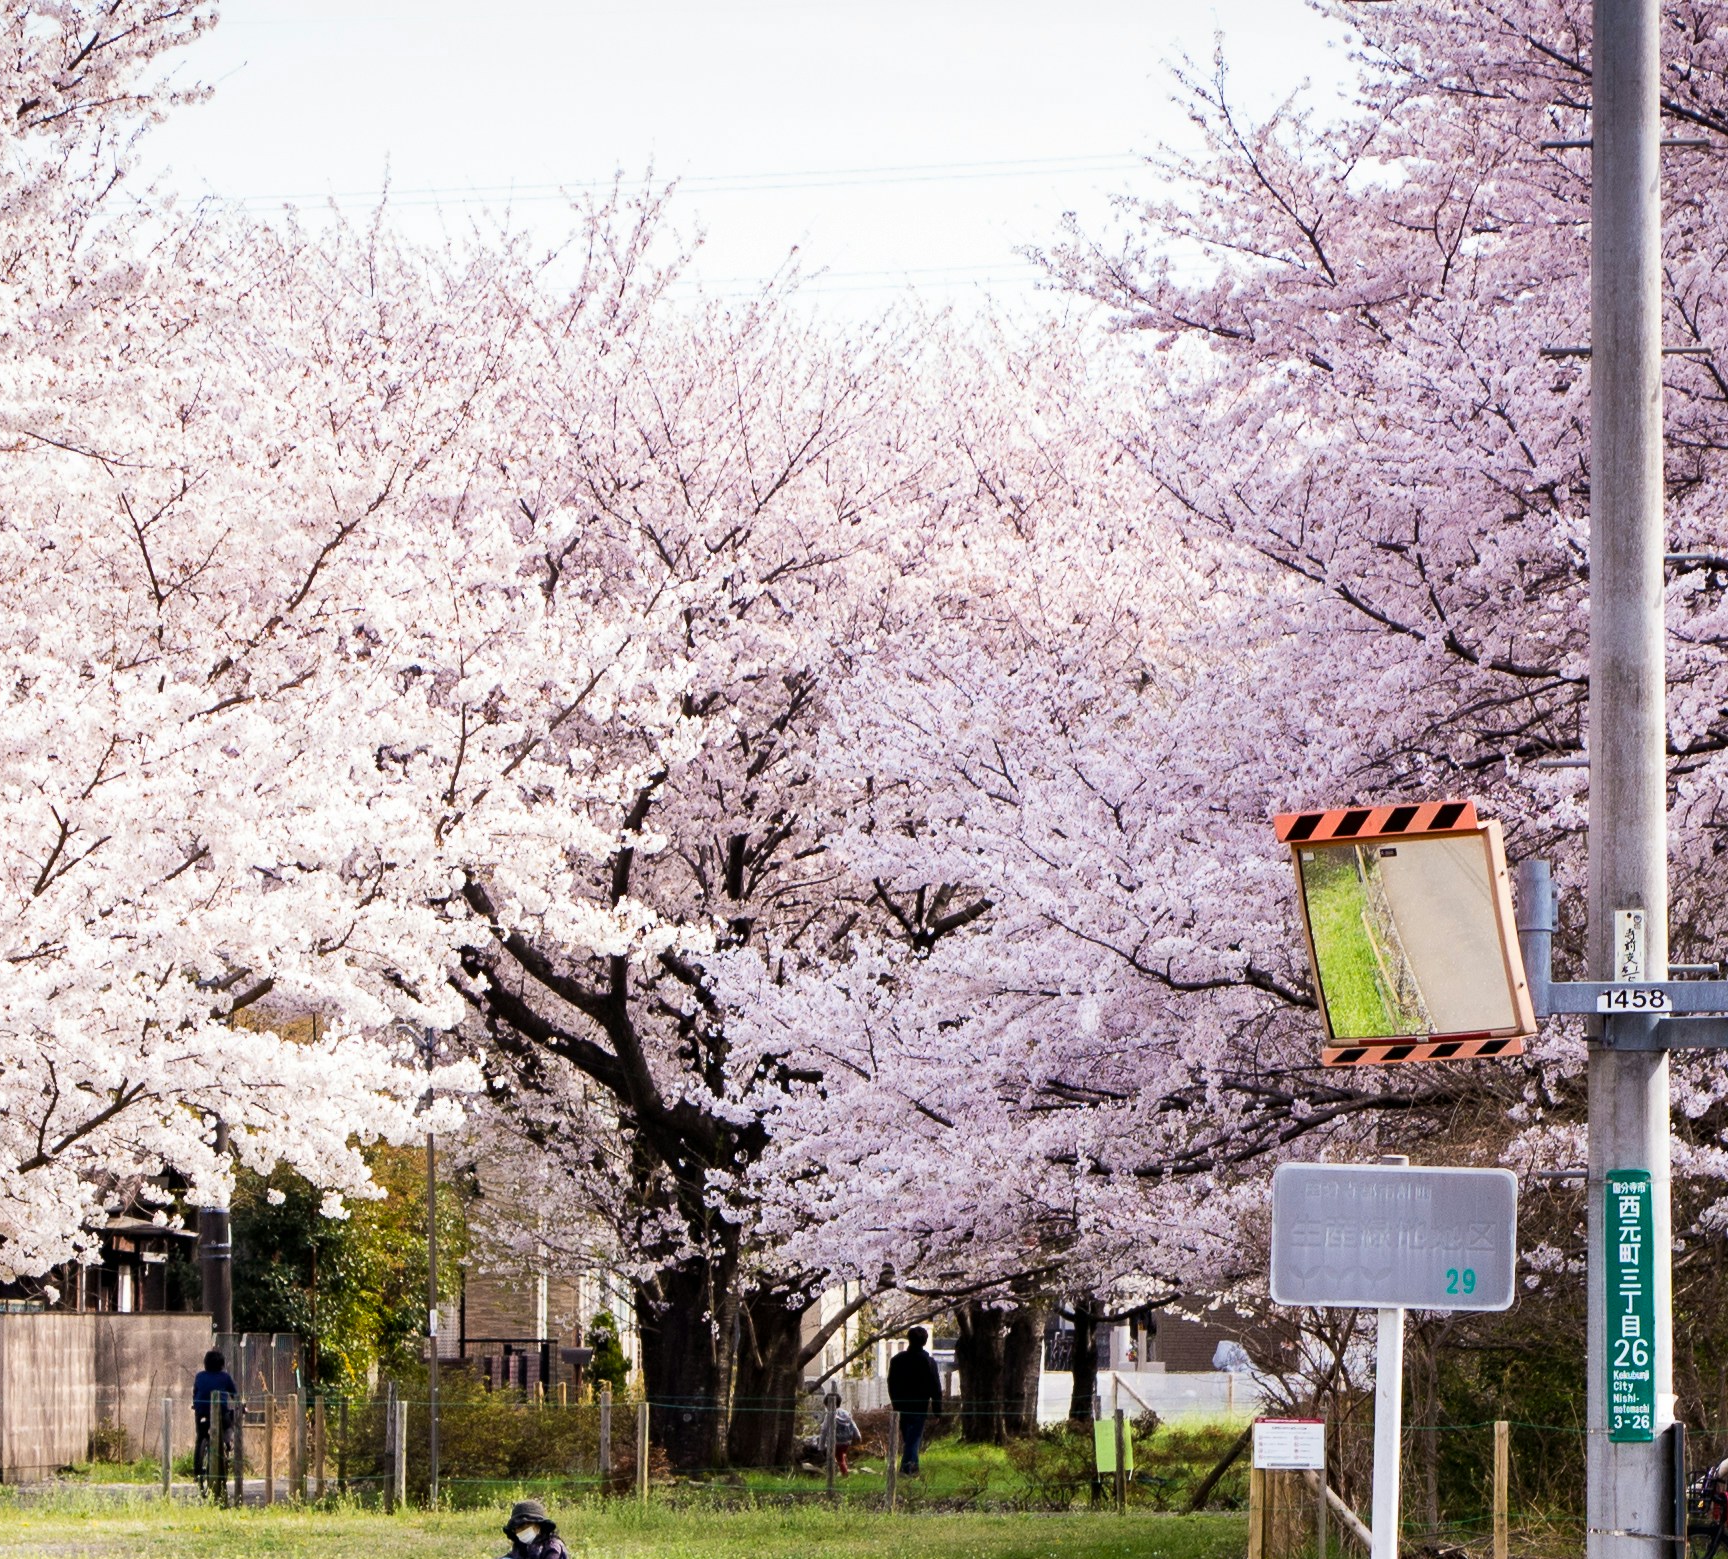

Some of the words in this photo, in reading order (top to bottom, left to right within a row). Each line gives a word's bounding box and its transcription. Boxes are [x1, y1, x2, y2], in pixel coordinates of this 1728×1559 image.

[1601, 989, 1665, 1009] 1458
[1612, 1182, 1646, 1194] 国分寺市
[1445, 1267, 1477, 1295] 29
[1613, 1338, 1649, 1367] 26
[1613, 1370, 1650, 1381] Kokubunji
[1613, 1381, 1634, 1393] City
[1613, 1393, 1640, 1403] Nishi-
[1613, 1403, 1650, 1414] motomachi
[1613, 1415, 1650, 1429] 3-26
